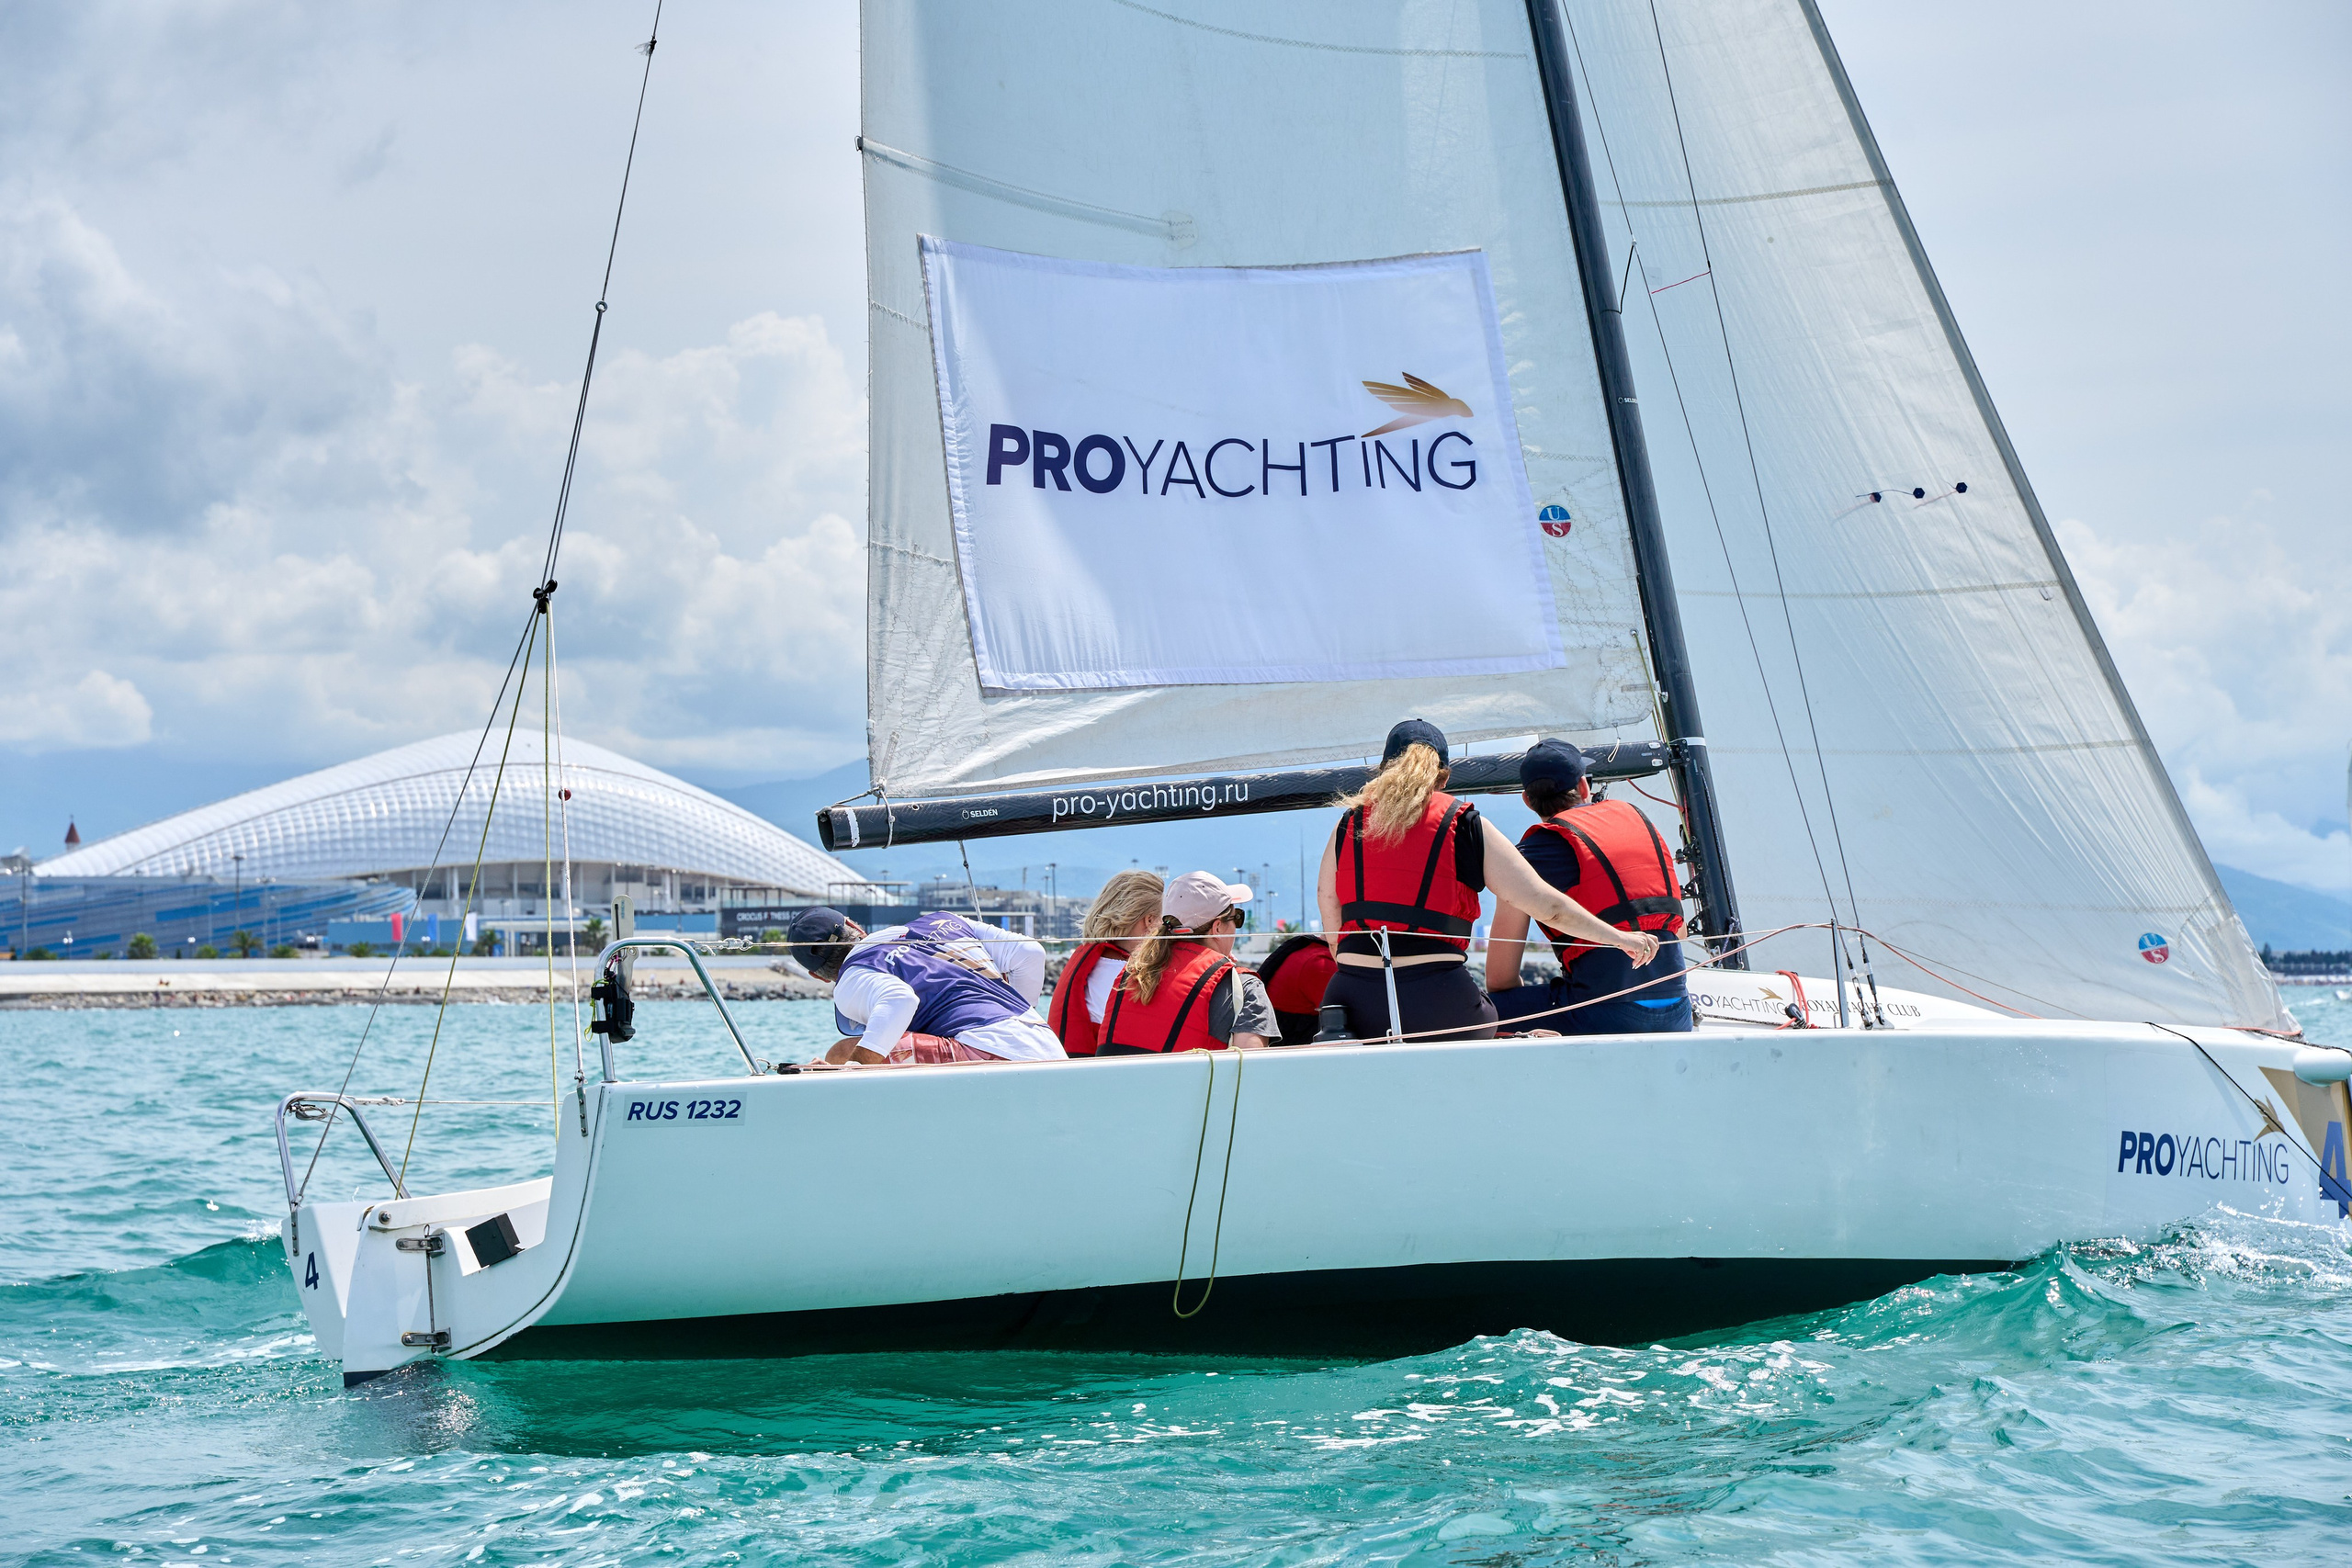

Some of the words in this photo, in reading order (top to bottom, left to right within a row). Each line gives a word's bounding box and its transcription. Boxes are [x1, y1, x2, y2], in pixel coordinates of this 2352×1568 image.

[986, 423, 1476, 498] PROYACHTING
[1052, 783, 1250, 822] pro-yachting.ru
[1688, 992, 1786, 1016] ROYACHTING
[1887, 1003, 1921, 1017] CLUB
[628, 1100, 680, 1121] RUS
[686, 1100, 741, 1119] 1232
[2118, 1131, 2289, 1184] PROYACHTING
[305, 1251, 320, 1291] 4
